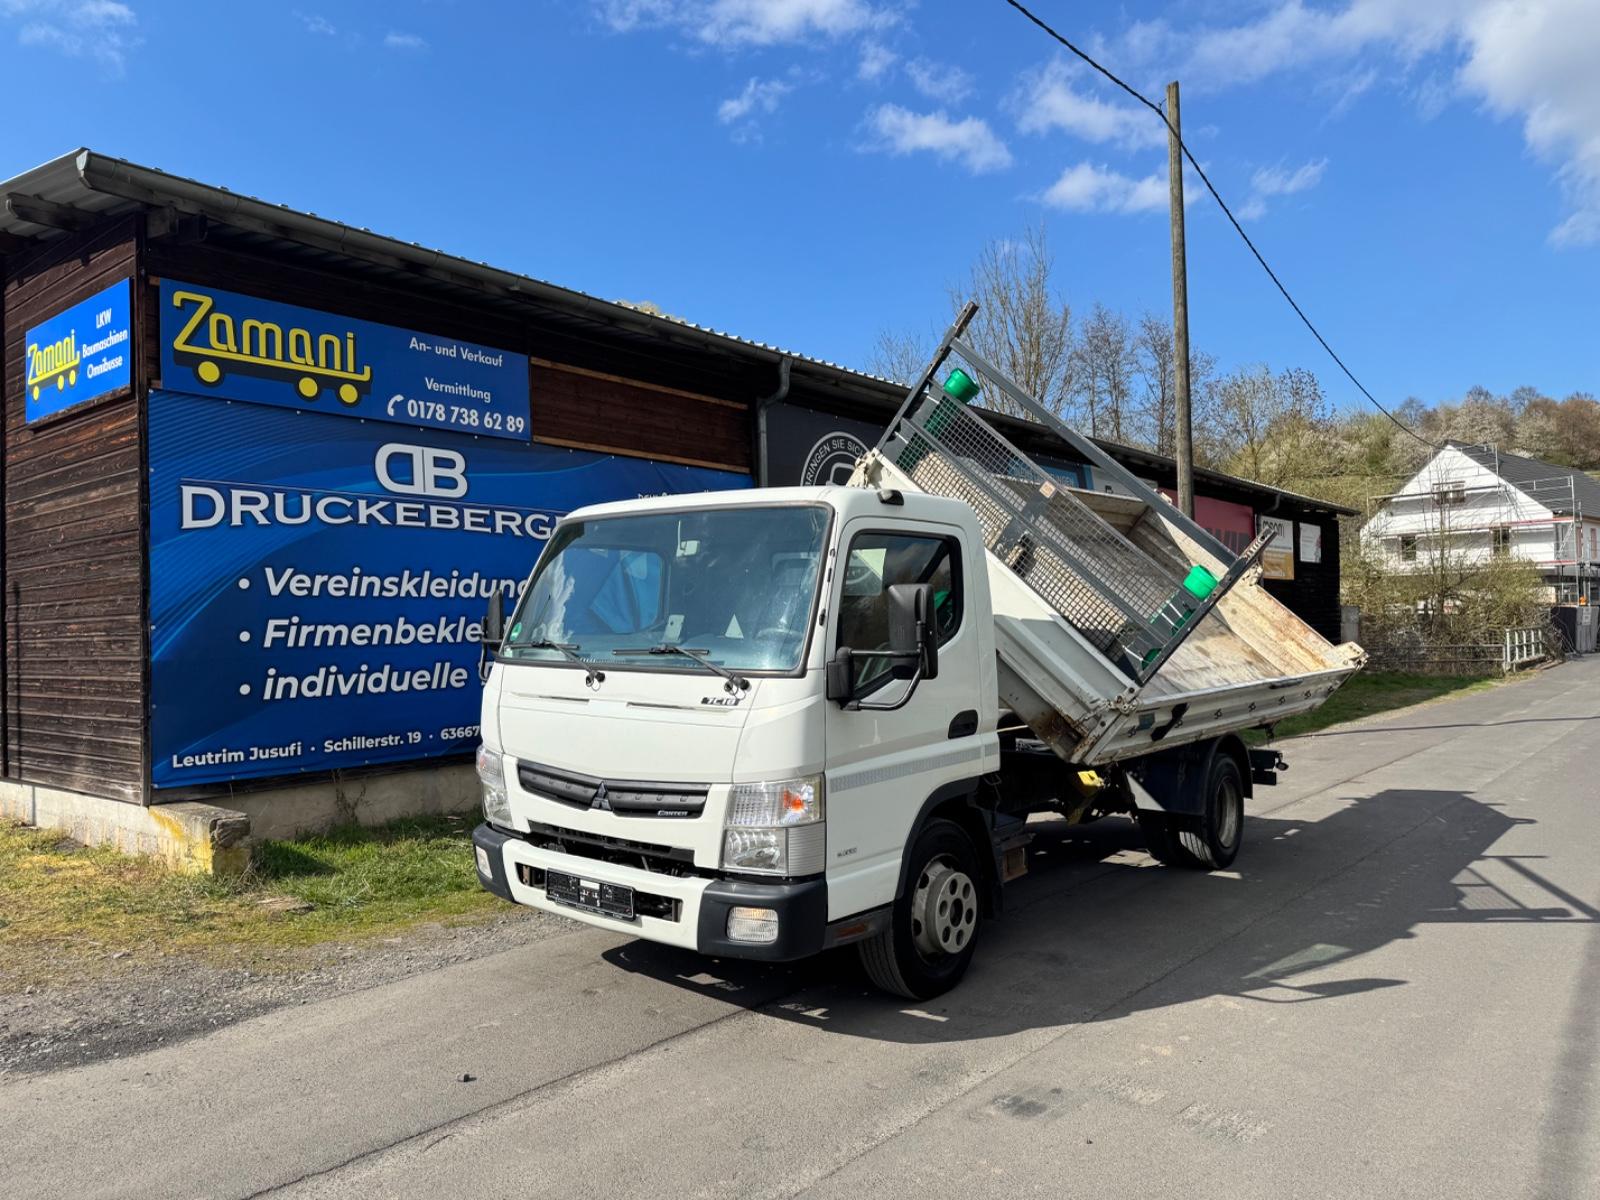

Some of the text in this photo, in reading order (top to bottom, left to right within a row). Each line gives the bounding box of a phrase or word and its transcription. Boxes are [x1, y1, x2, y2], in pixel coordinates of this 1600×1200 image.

[95, 308, 112, 329] LKW
[82, 329, 128, 358] Baumaschinen
[173, 290, 371, 381] Zamani
[28, 328, 80, 385] Zamani
[87, 355, 123, 379] Omnibusse
[409, 336, 503, 367] An- und Verkauf
[425, 377, 491, 403] Vermittlung
[407, 399, 525, 433] 0178 738 62 89
[831, 439, 846, 449] SIE
[263, 662, 468, 700] individuelle
[172, 725, 480, 768] Leutrim Jusufi Schillerstr. 19 63667
